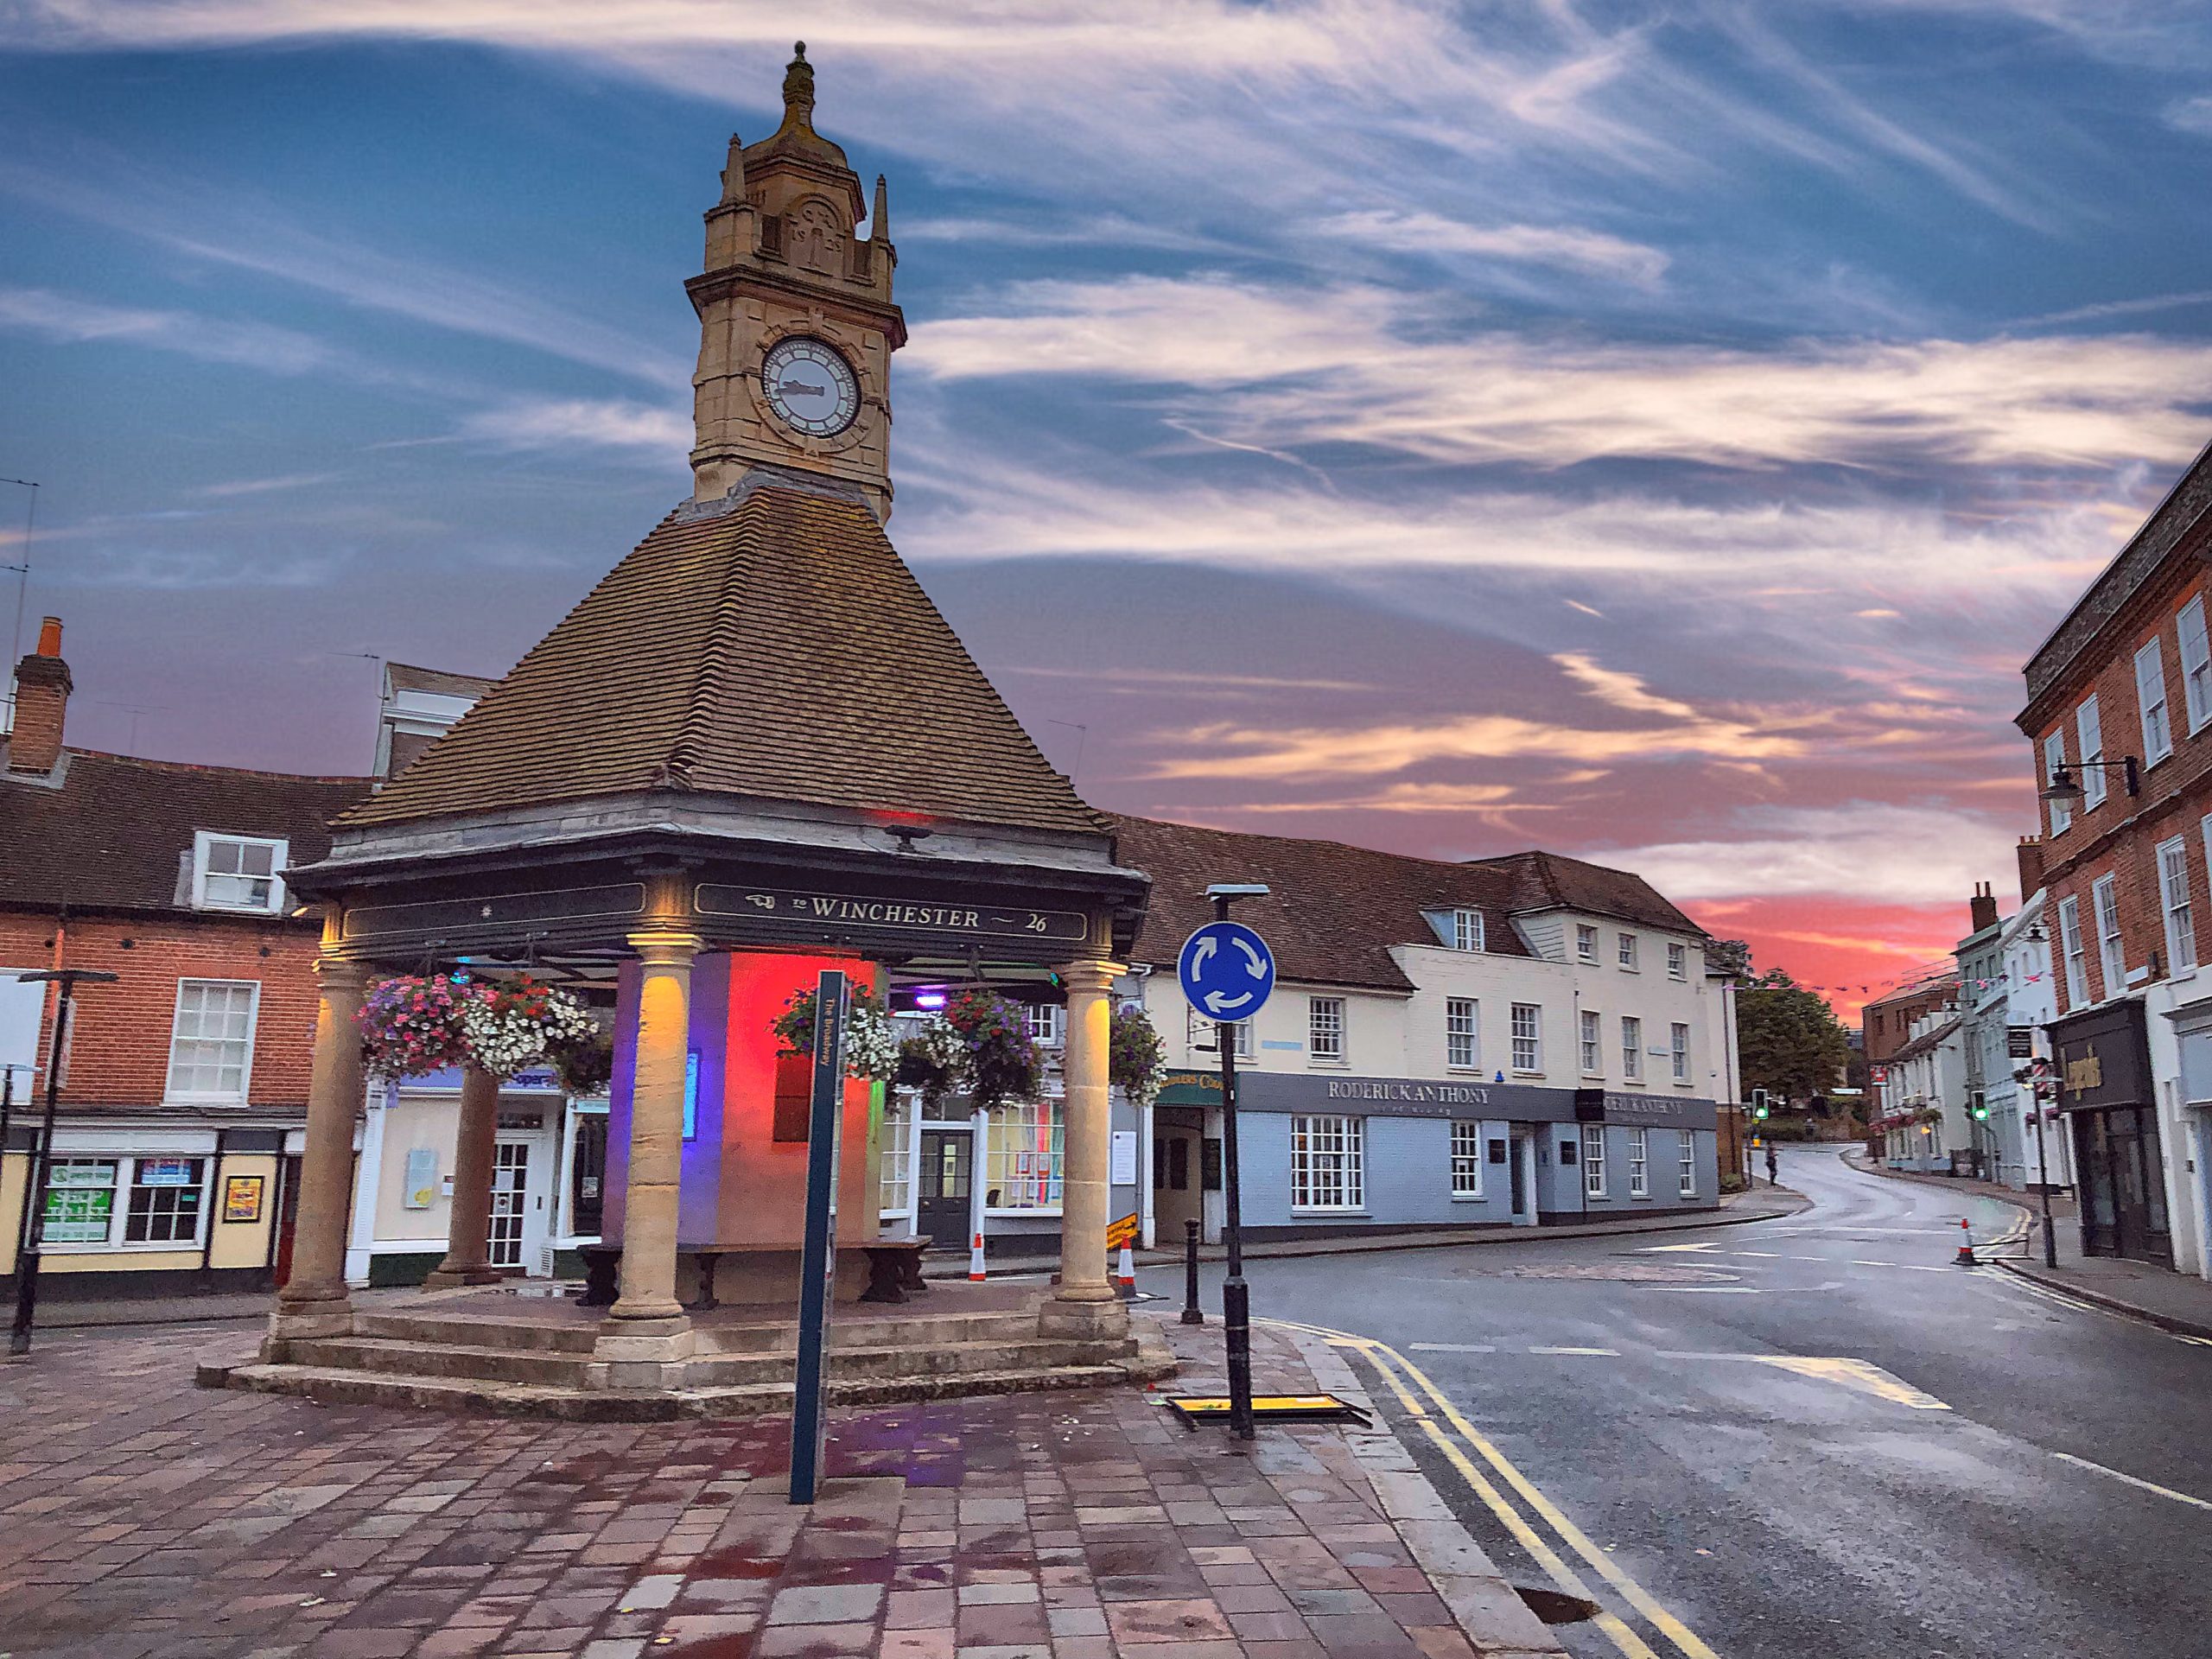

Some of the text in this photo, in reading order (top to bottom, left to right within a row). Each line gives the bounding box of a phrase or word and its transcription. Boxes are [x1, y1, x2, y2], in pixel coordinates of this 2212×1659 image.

[810, 897, 980, 928] WINCHESTER
[1024, 912, 1047, 932] 26
[819, 997, 837, 1067] The Broadway
[1328, 1081, 1491, 1104] RODERICK ANTHONY
